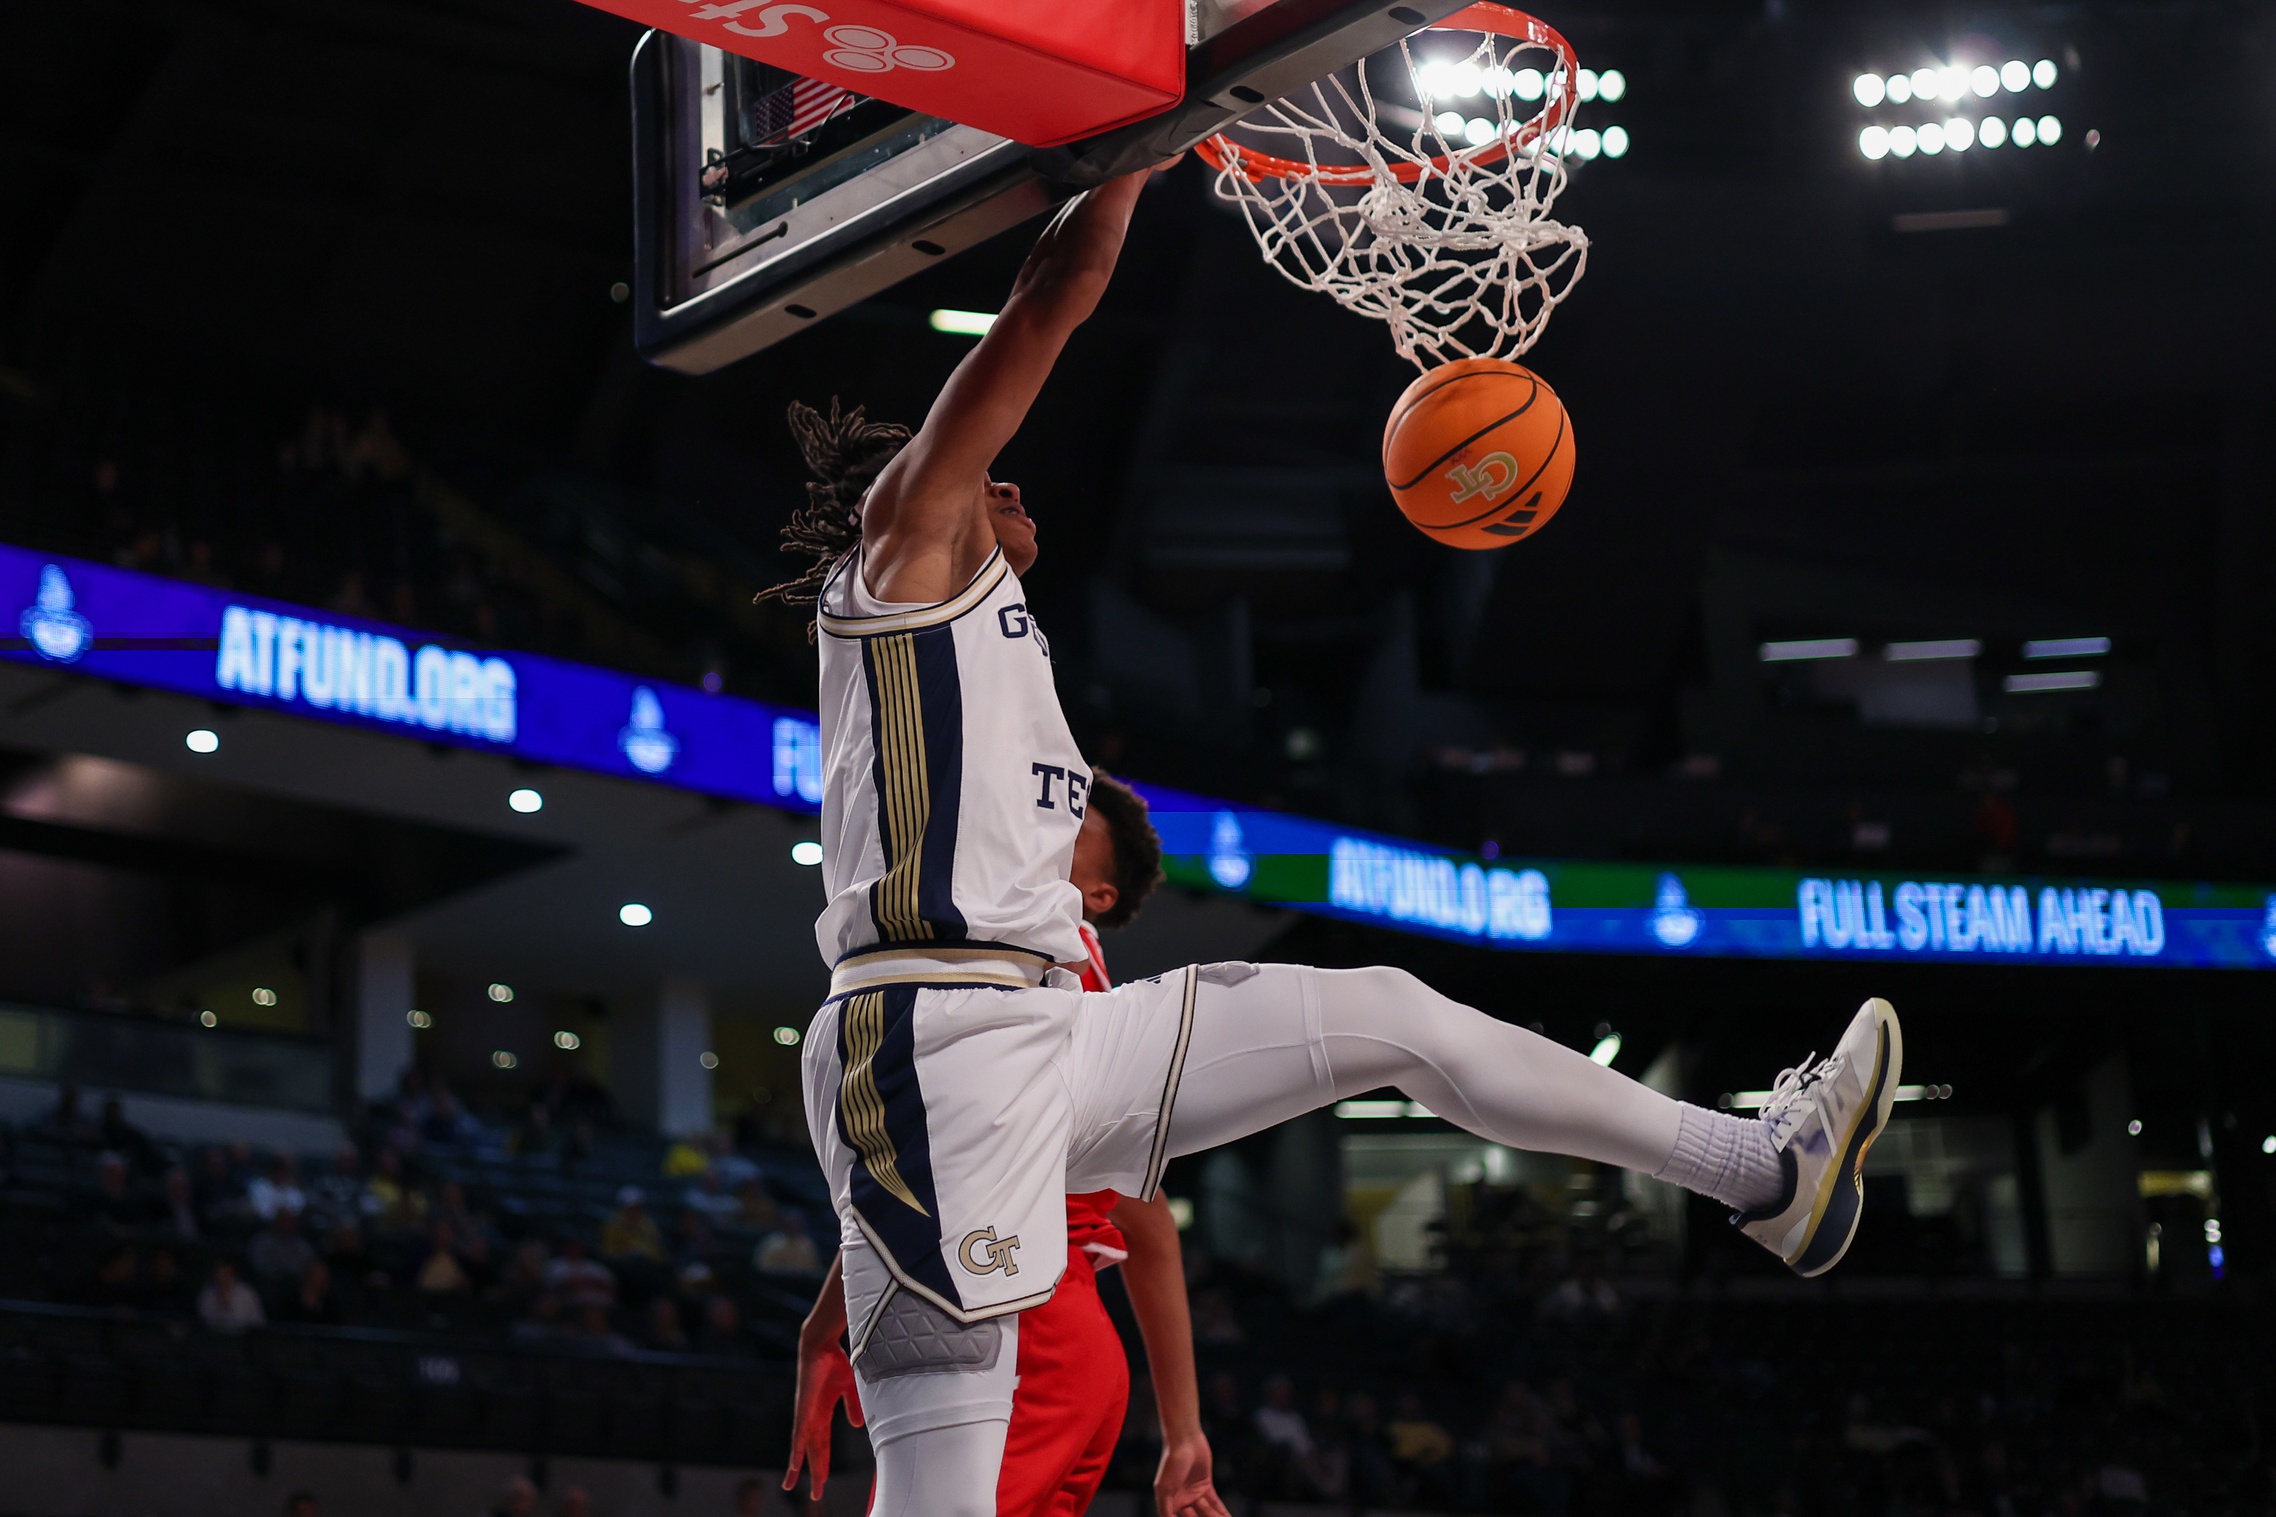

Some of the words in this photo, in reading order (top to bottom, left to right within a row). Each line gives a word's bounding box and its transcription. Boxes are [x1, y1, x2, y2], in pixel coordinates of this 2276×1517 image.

[677, 0, 833, 37] St
[217, 605, 518, 743] ATFUND.ORG
[1032, 762, 1091, 820] TE
[1799, 878, 1895, 950] FULL
[1894, 882, 2033, 953] STEAM
[2038, 886, 2164, 957] AHEAD
[958, 1225, 1020, 1277] GT
